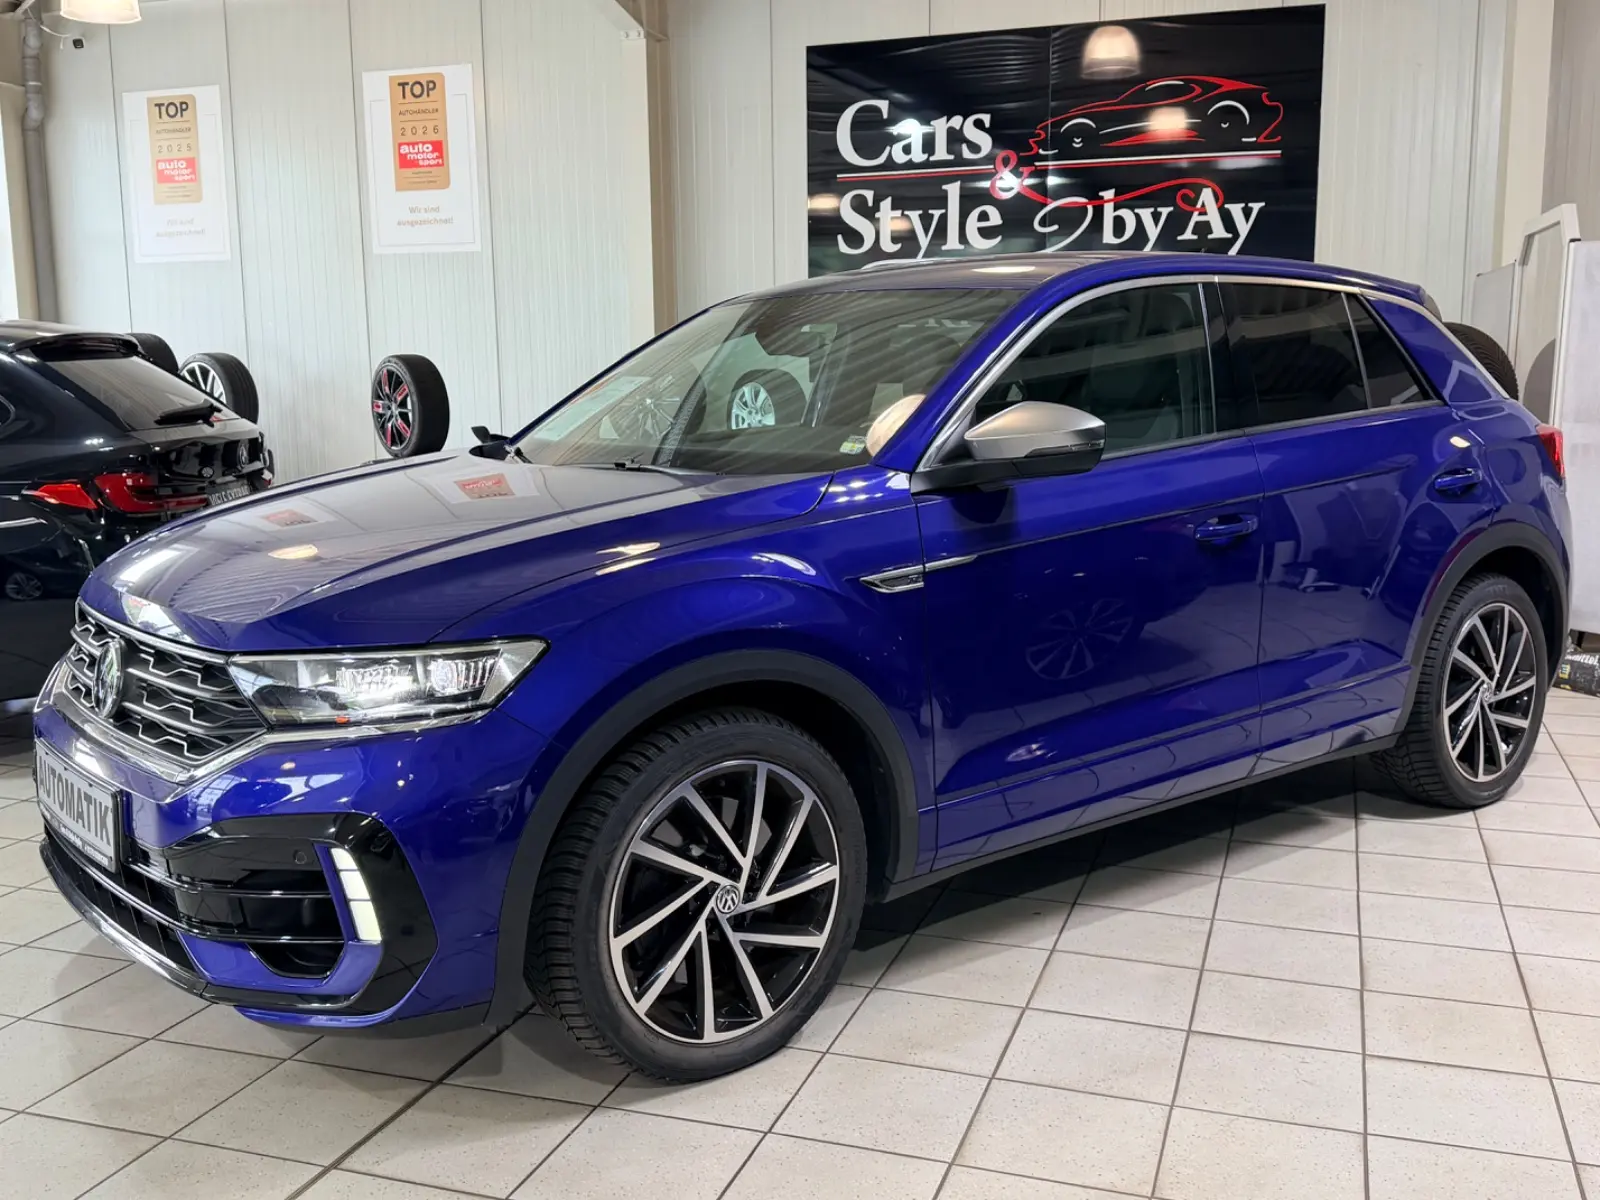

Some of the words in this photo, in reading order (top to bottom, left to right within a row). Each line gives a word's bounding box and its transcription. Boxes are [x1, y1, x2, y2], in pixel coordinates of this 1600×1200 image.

[397, 79, 437, 99] TOP
[154, 101, 189, 120] TOP
[399, 143, 433, 154] auto
[836, 99, 992, 167] Cars
[989, 149, 1033, 200] &
[158, 159, 187, 170] auto
[836, 180, 1003, 260] Style
[1100, 190, 1173, 252] by
[1178, 187, 1265, 257] Ay
[38, 755, 111, 847] AUTOMATIK
